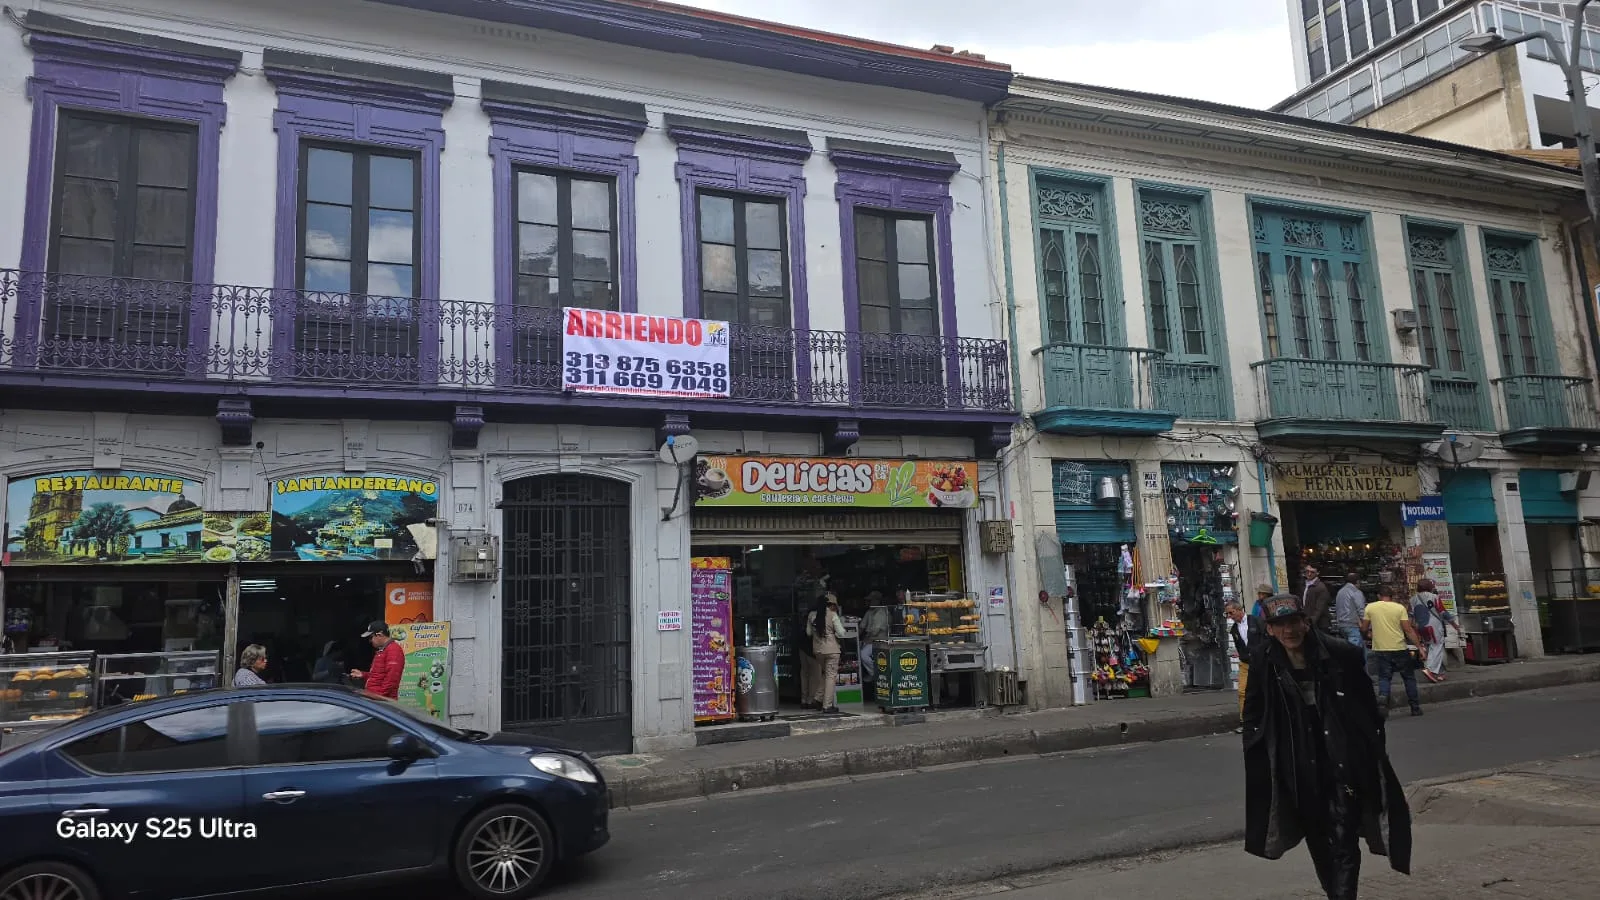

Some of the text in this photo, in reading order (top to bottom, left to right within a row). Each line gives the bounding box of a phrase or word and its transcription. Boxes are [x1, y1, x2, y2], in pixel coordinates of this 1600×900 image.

[566, 309, 703, 347] ARRIENDO
[565, 351, 727, 377] 313 875 6358
[565, 367, 607, 385] 311
[613, 371, 663, 389] 669
[668, 375, 727, 393] 7049
[1372, 466, 1413, 477] PASAJE
[35, 475, 184, 494] RESTAURANTE
[276, 476, 437, 495] SANTANDEREANO
[1305, 477, 1394, 491] HERNANDEZ
[1286, 491, 1409, 501] MERCANCIAS EN GENERAL
[1407, 506, 1437, 516] NOTARIA
[390, 588, 406, 605] G
